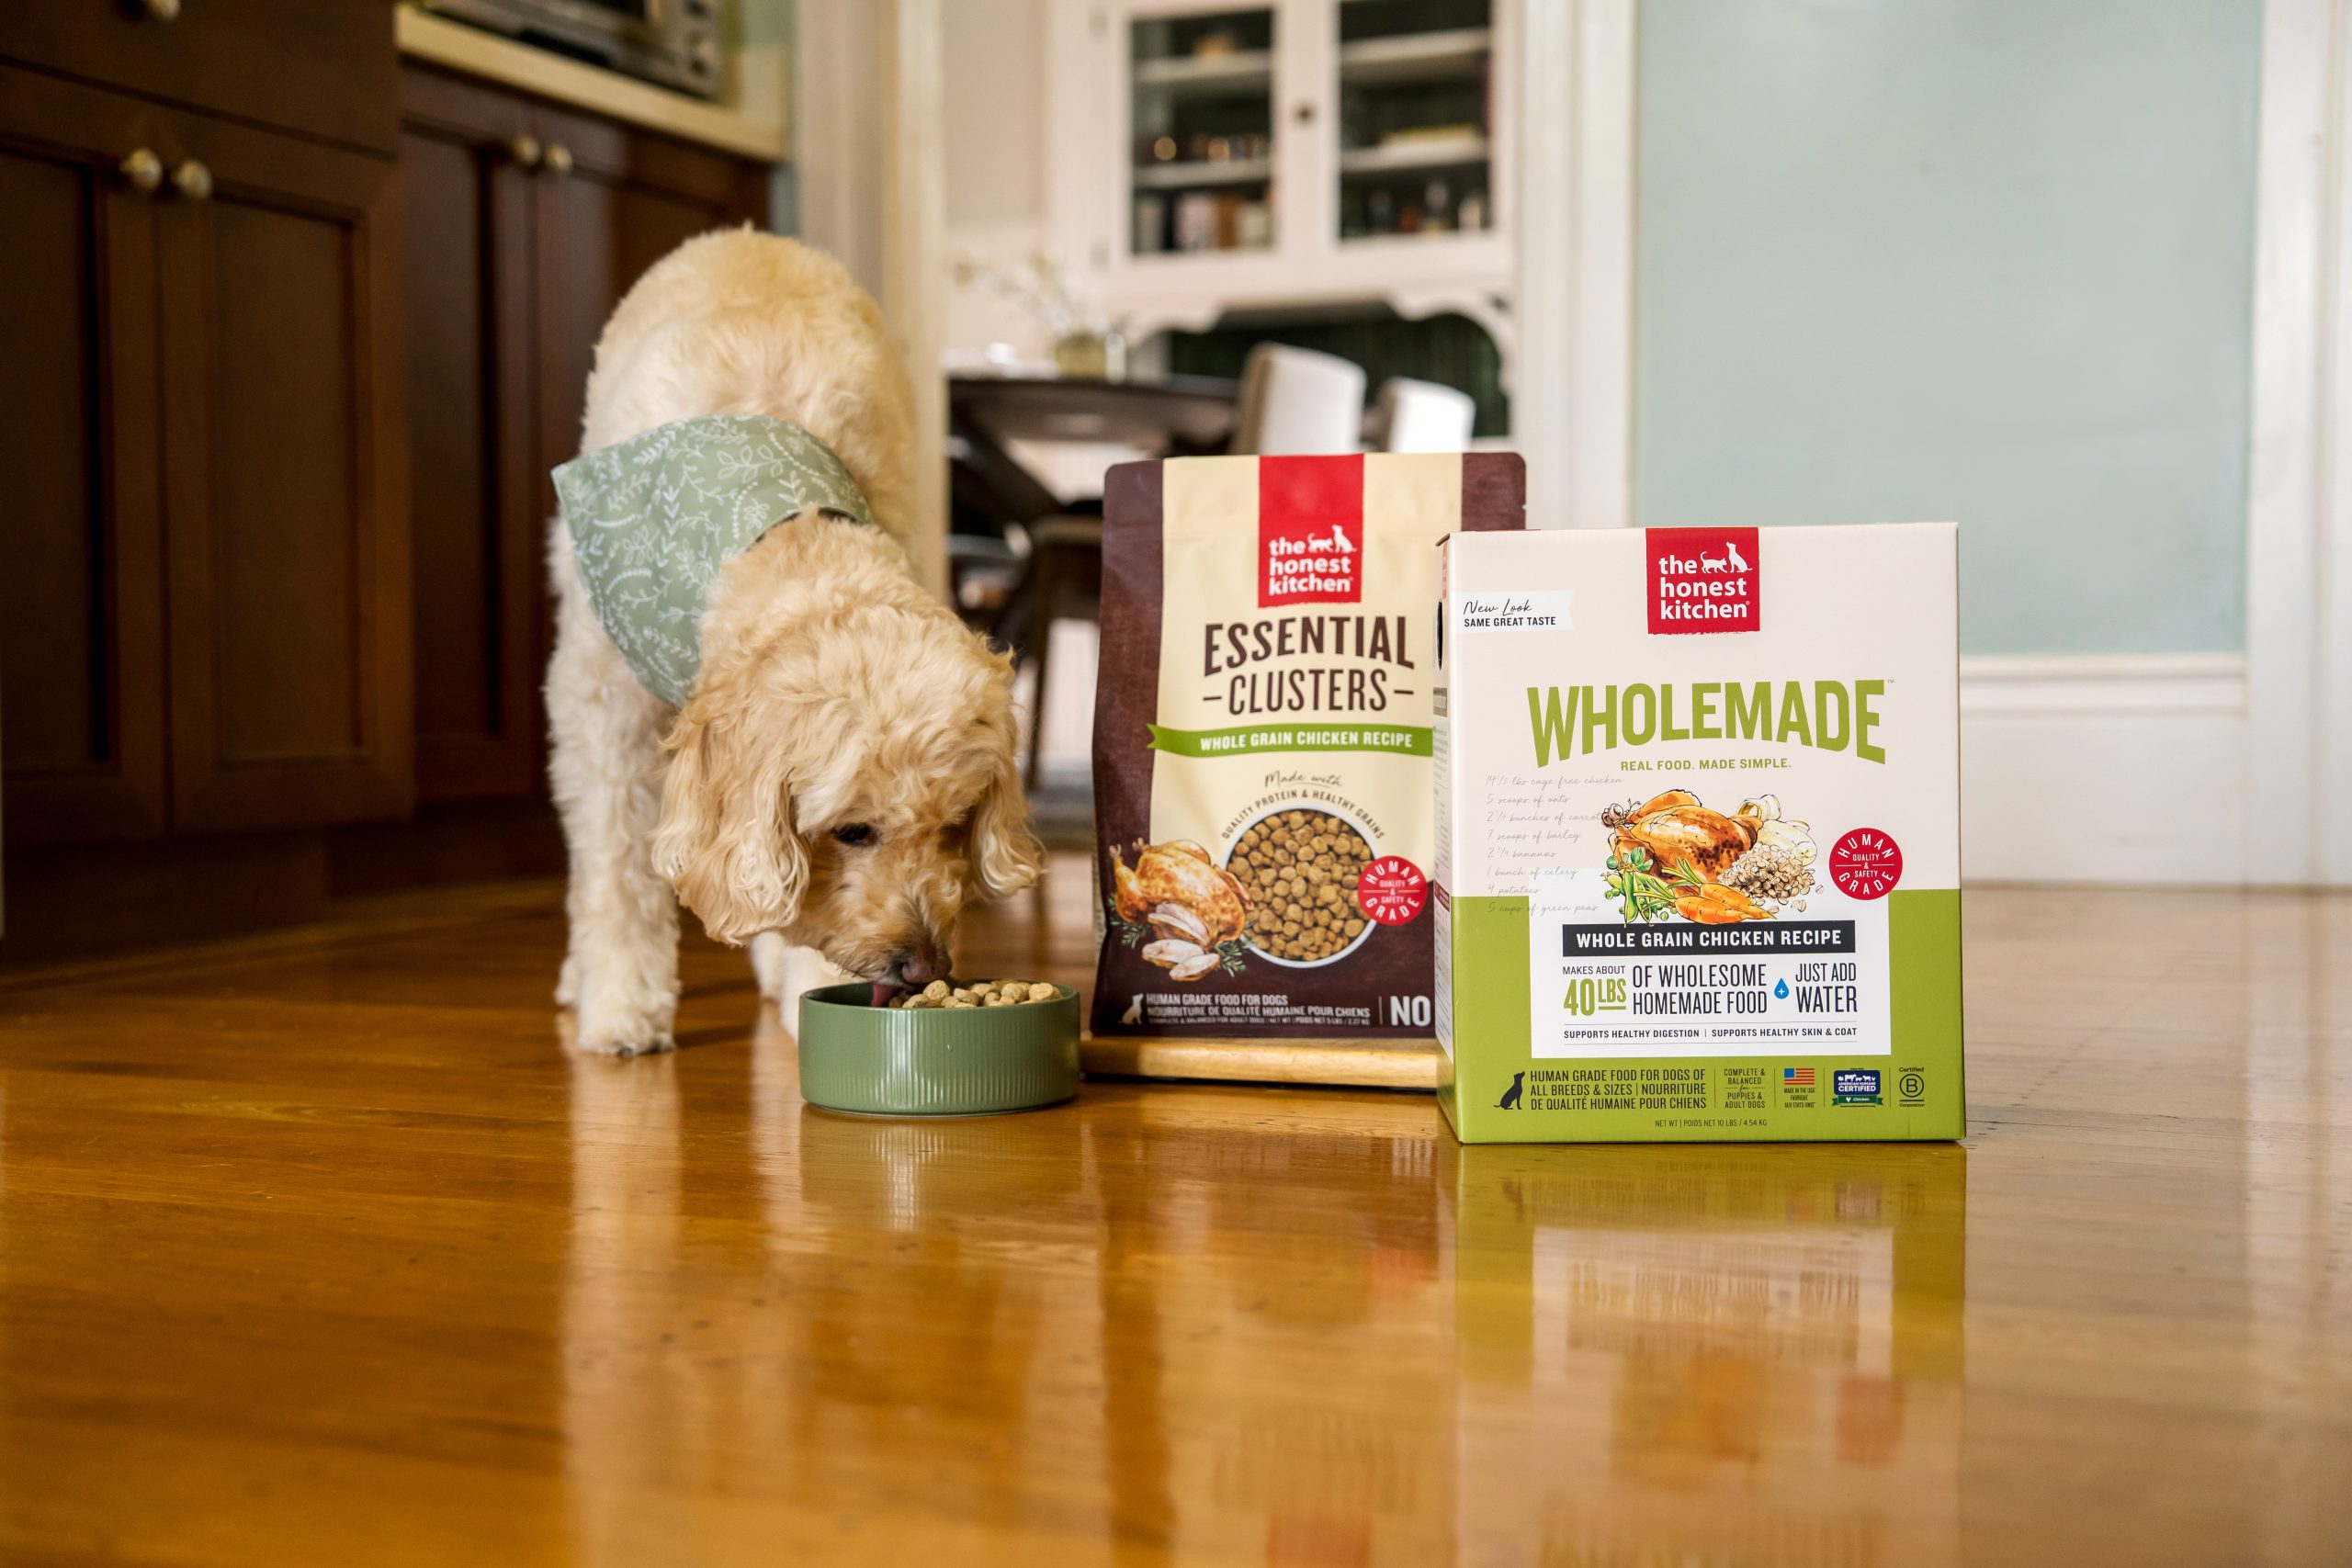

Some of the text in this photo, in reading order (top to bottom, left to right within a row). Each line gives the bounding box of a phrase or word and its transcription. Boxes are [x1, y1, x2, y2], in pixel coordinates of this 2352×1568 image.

[1269, 536, 1306, 557] the
[1270, 556, 1351, 576] honest
[1658, 554, 1698, 575] the
[1269, 572, 1351, 595] kitchen
[1660, 577, 1747, 598] honest
[1463, 598, 1532, 616] New Look
[1660, 599, 1747, 620] kitchen
[1464, 616, 1556, 627] SAME GREAT TASTE
[1204, 615, 1415, 677] ESSENTIAL
[1229, 669, 1387, 715] CLUSTERS
[1527, 679, 1886, 769] WHOLEMADE
[1200, 731, 1412, 750] WHOLE GRAIN CHICKEN RECIPE
[1620, 758, 1792, 772] REAL FOOD. MADE SIMPLE.
[1264, 770, 1343, 788] Made with
[1557, 775, 1580, 790] free
[1584, 774, 1624, 784] chicken
[1486, 794, 1494, 805] 5
[1532, 794, 1545, 807] of
[1547, 794, 1570, 803] oats
[1222, 789, 1385, 840] QUALITY PROTEIN & HEALTHY GRAINS
[1510, 811, 1550, 822] bunches
[1554, 811, 1566, 825] of
[1532, 829, 1543, 843] of
[1546, 829, 1581, 843] barley
[1512, 848, 1557, 858] bananas
[1838, 834, 1894, 858] HUMAN
[1852, 853, 1880, 862] QUALITY
[1863, 862, 1869, 870] &
[1365, 861, 1420, 886] HUMAN
[1495, 866, 1524, 876] bunch
[1529, 867, 1542, 880] of
[1544, 866, 1578, 880] celery
[1854, 870, 1878, 878] SAFETY
[1487, 884, 1541, 897] 4 potatoes
[1838, 871, 1894, 895] GRADE
[1365, 897, 1419, 920] GRADE
[1488, 902, 1600, 916] 5 cups of green peas
[1577, 929, 1841, 949] WHOLE GRAIN CHICKEN RECIPE
[1563, 965, 1625, 975] MAKES ABOUT
[1633, 964, 1767, 987] OF WHOLESOME
[1795, 963, 1857, 982] JUST ADD
[1147, 993, 1288, 1006] HUMAN GRADE FOOD FOR DOGS
[1564, 978, 1626, 1016] 40 LBS
[1633, 990, 1768, 1015] HOMEMADE FOOD
[1795, 986, 1858, 1013] WATER
[1262, 1006, 1306, 1016] HUMAINE
[1307, 1006, 1334, 1016] POUR
[1335, 1007, 1371, 1018] CHIENS
[1390, 995, 1430, 1026] NO
[1564, 1030, 1700, 1039] SUPPORTS HEALTHY DIGESTION
[1712, 1027, 1858, 1037] SUPPORTS HEALTHY SKIN & COAT
[1530, 1069, 1706, 1082] HUMAN GRADE FOOD FOR DOGS OF
[1531, 1084, 1633, 1096] ALL BREEDS & SIZES
[1641, 1083, 1706, 1095] NOURRITURE
[1906, 1078, 1917, 1093] B
[1531, 1096, 1707, 1111] DE QUALITÉ HUMAINE POUR CHIENS
